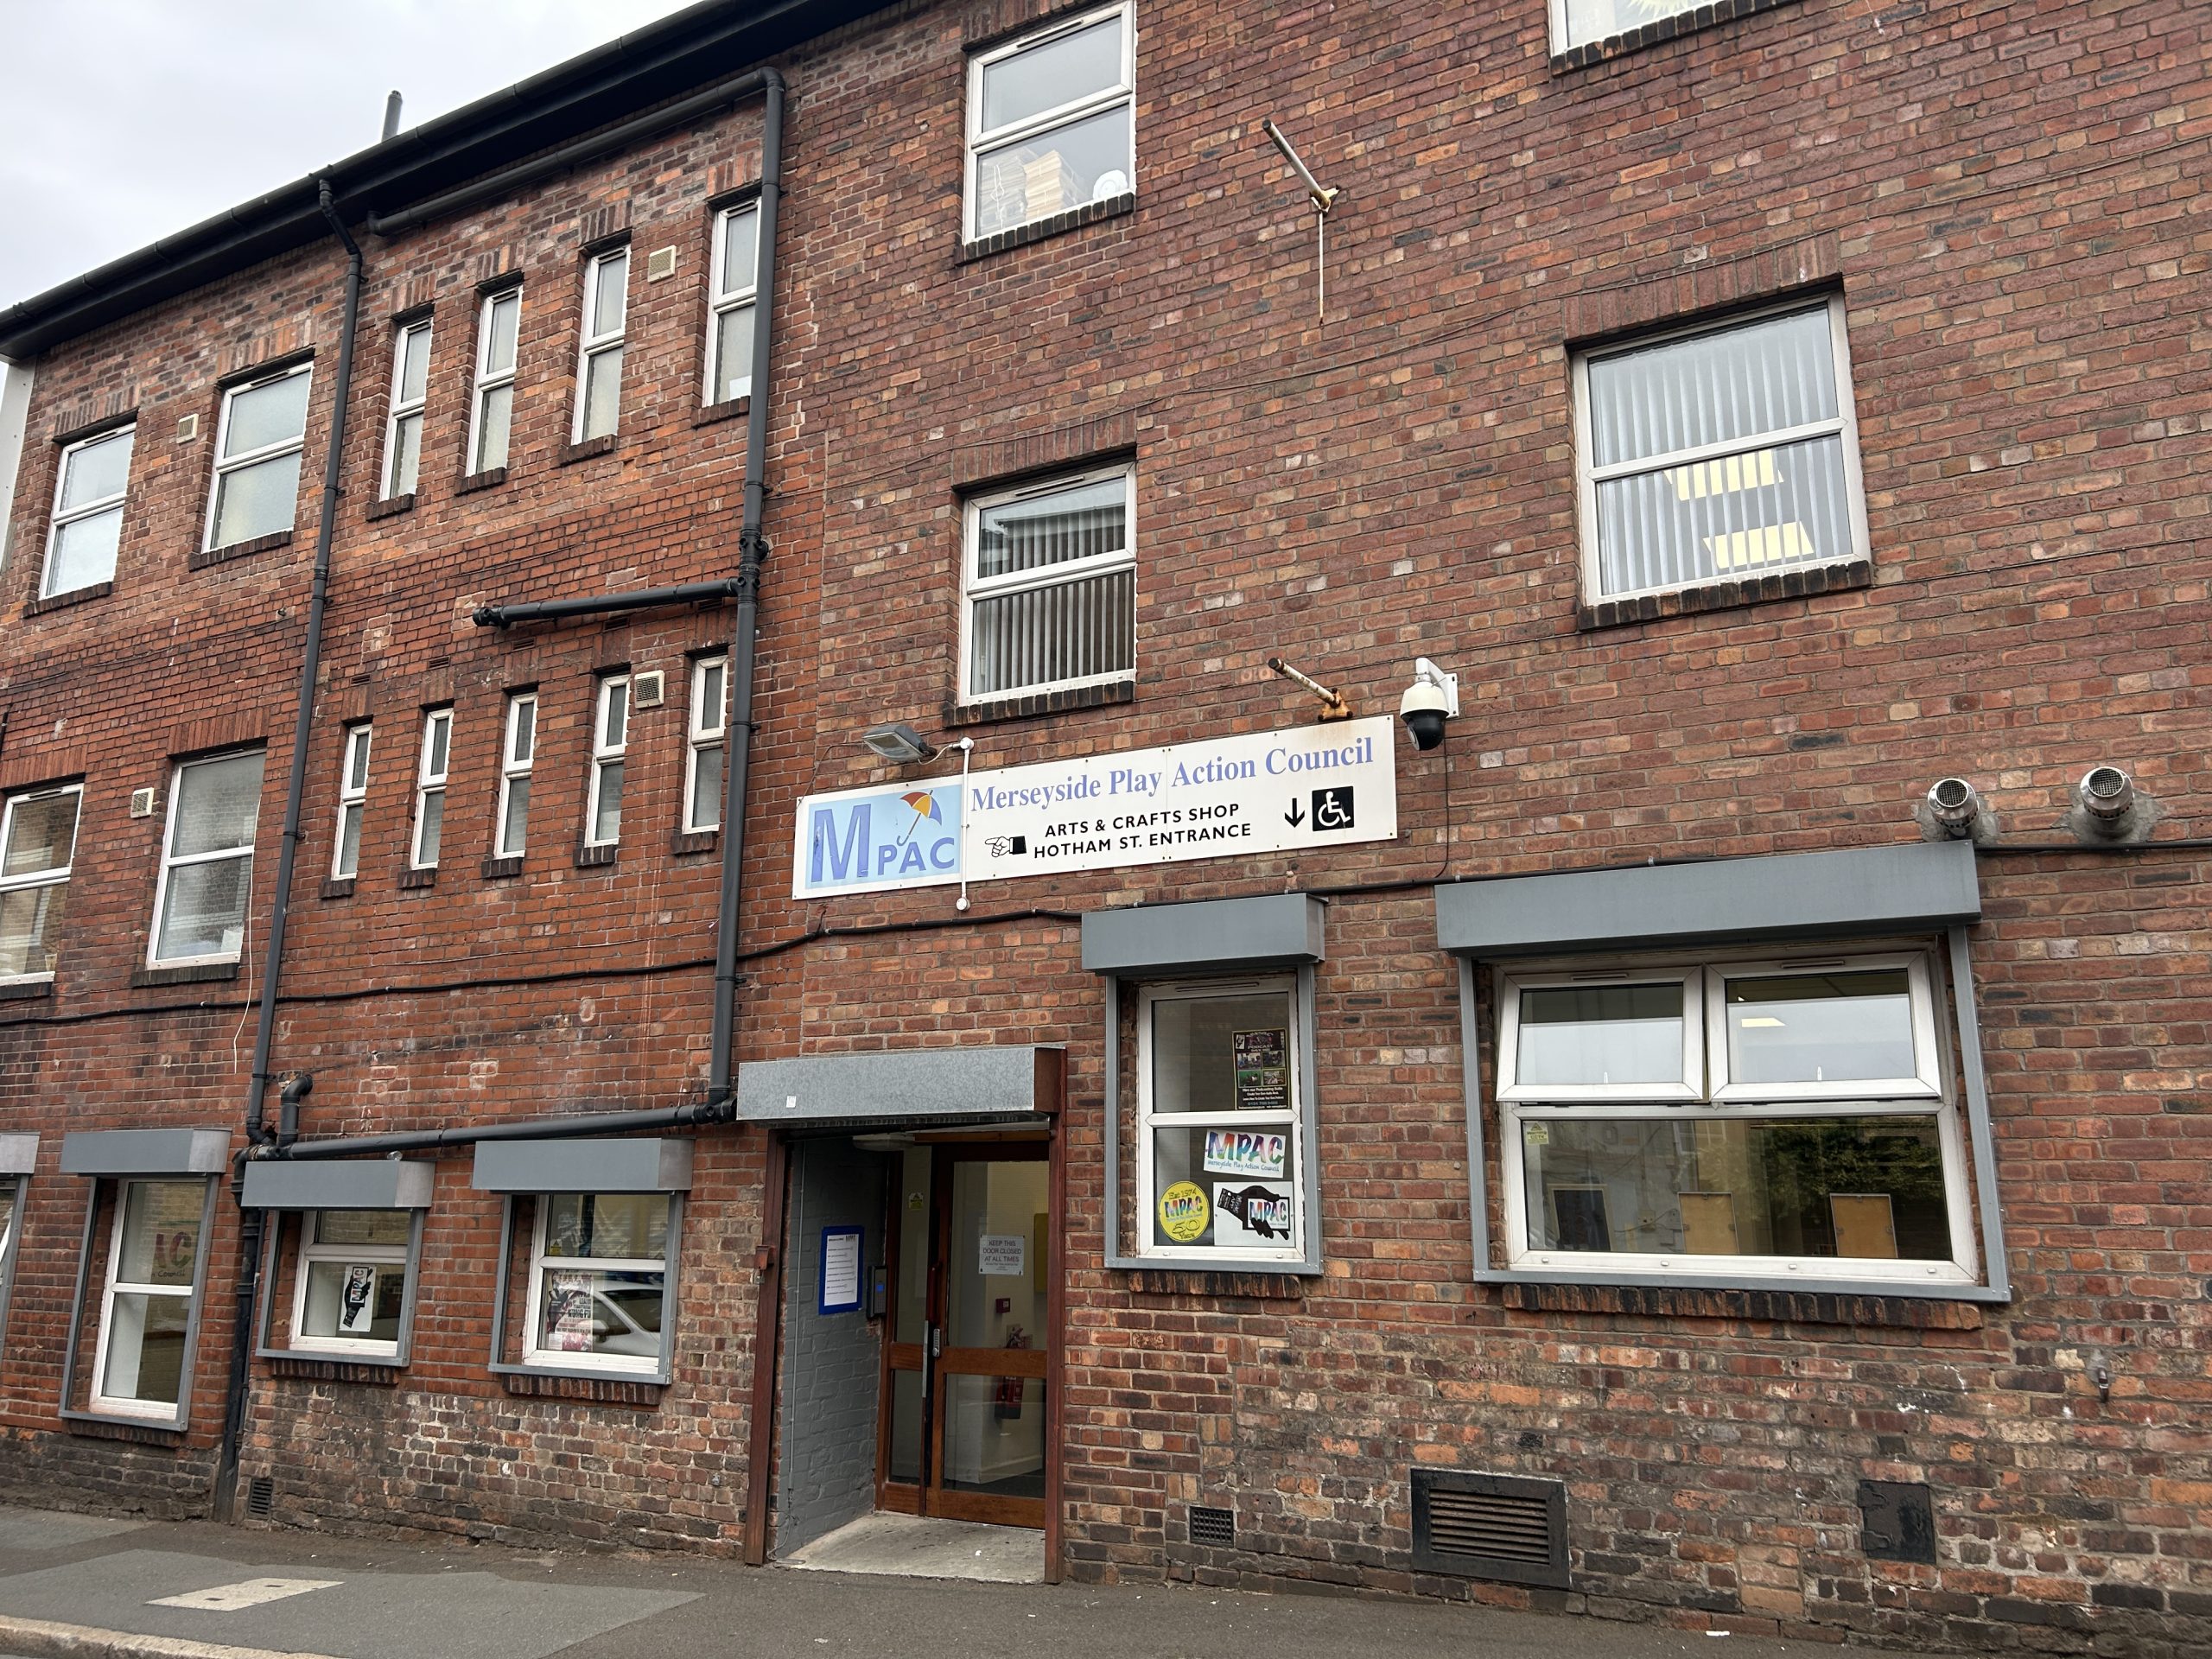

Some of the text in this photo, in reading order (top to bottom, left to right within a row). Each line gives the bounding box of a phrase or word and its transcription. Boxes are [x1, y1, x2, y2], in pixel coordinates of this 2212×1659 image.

[970, 736, 1374, 812] Merseyside Play Action Council
[1045, 803, 1240, 838] ARTS & CRAFTS SHOP
[1033, 823, 1252, 859] HOTHAM ST. ENTRANCE
[1207, 1131, 1283, 1165] MPAC
[1233, 1160, 1243, 1171] Play
[1164, 1195, 1204, 1218] MPAC
[1249, 1200, 1287, 1222] MPAC
